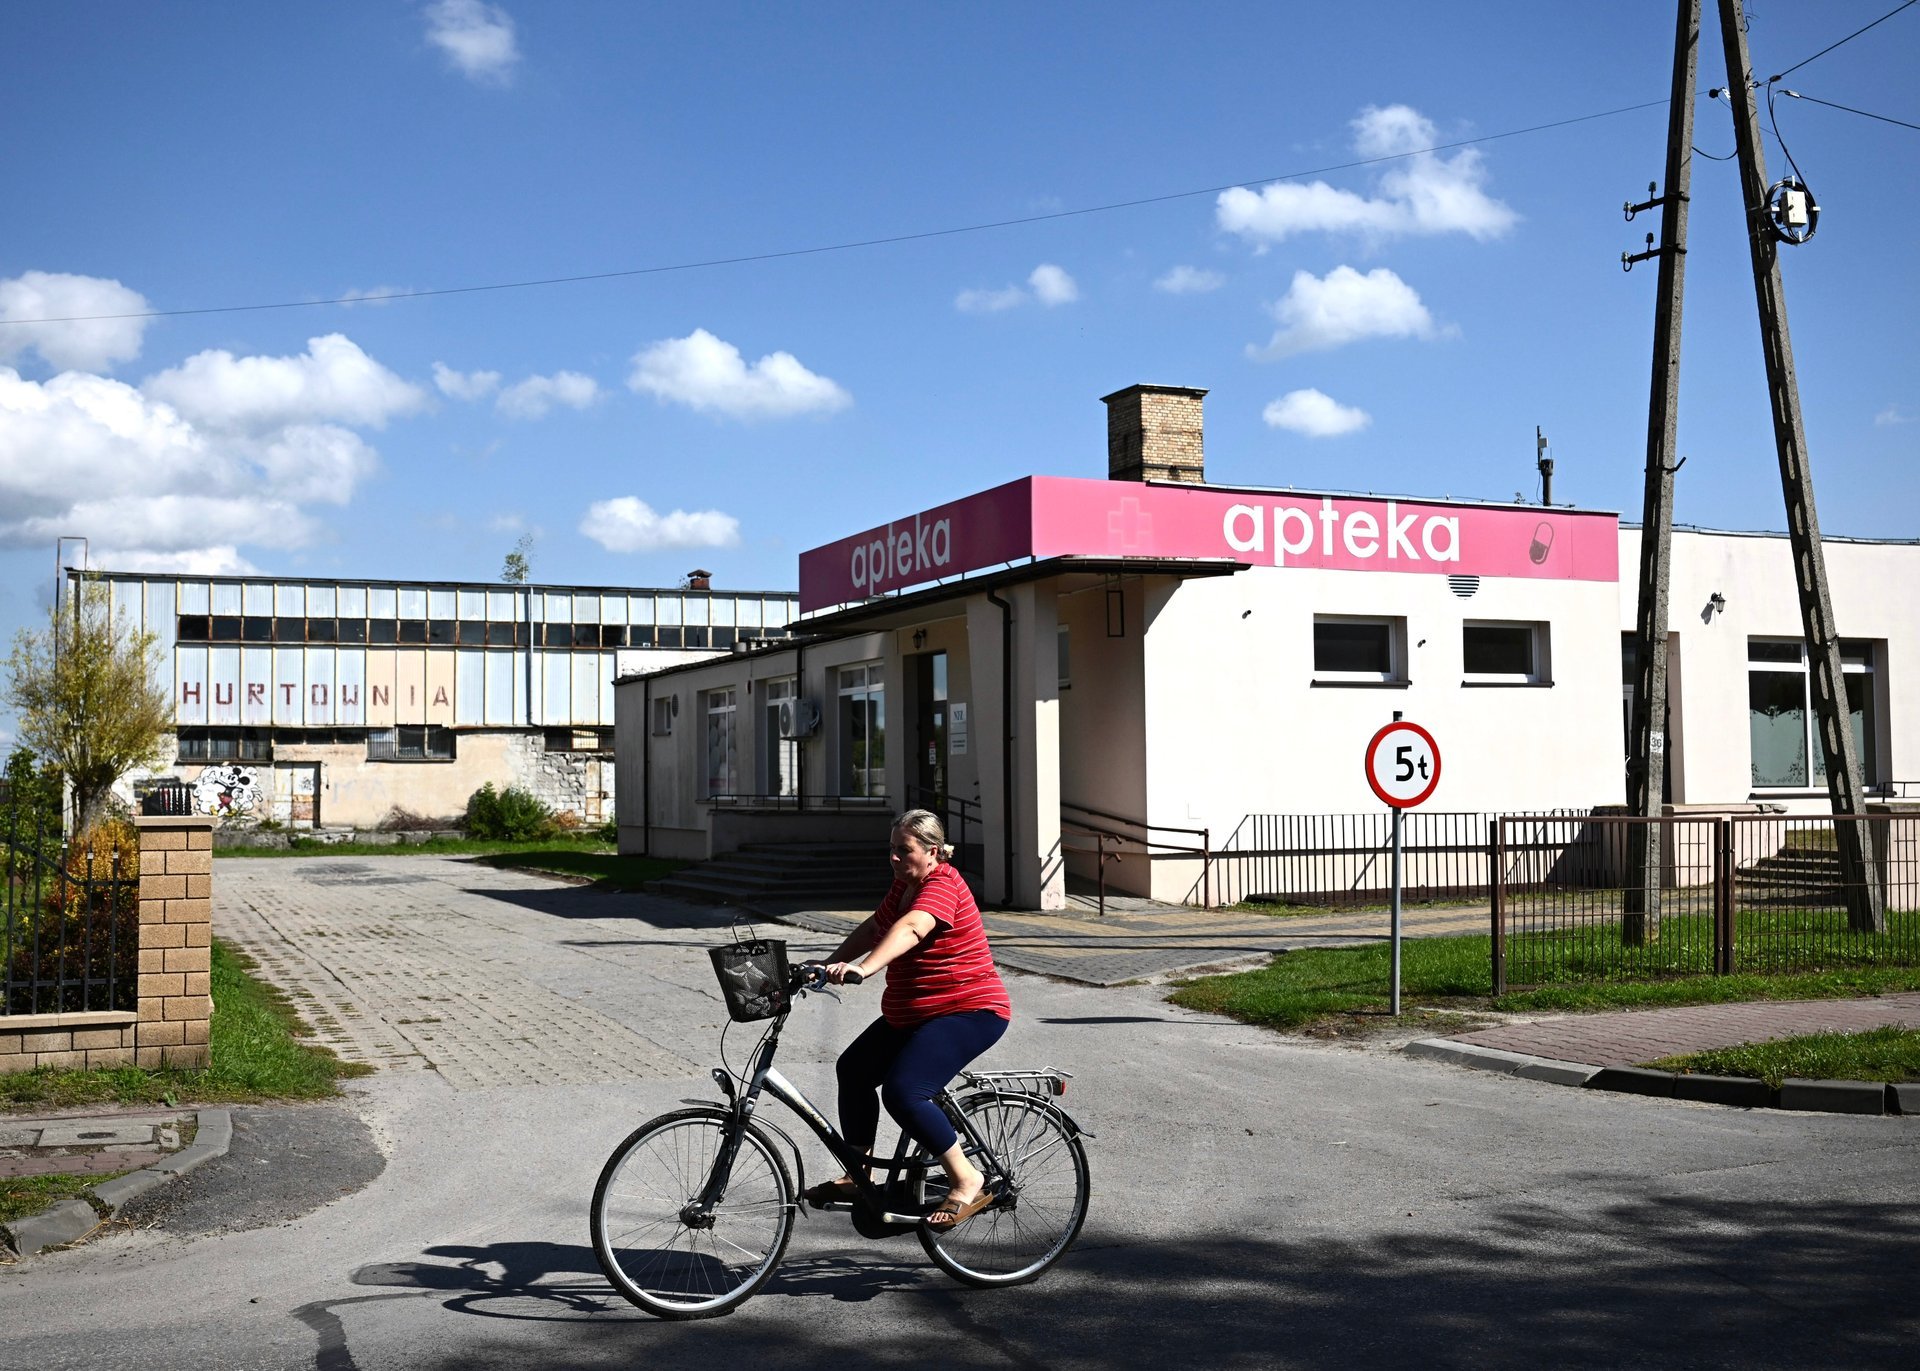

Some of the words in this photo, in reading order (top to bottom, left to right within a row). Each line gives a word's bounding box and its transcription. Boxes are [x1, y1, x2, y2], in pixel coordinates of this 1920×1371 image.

[1222, 497, 1461, 567] apteka
[851, 513, 950, 596] apteka
[182, 681, 450, 706] HURTOWNIA
[1651, 737, 1662, 748] 36
[1395, 745, 1429, 782] 5t
